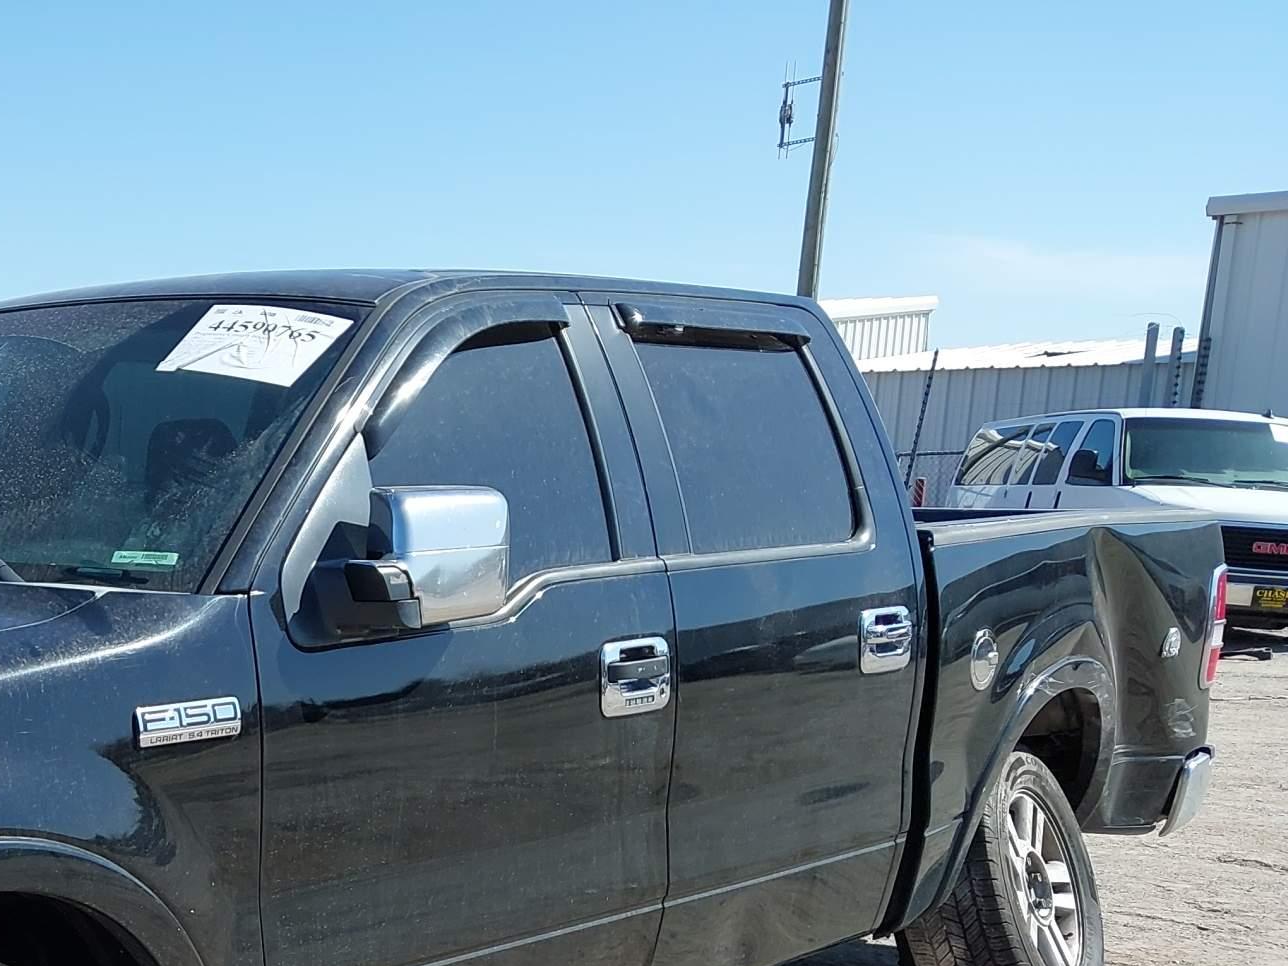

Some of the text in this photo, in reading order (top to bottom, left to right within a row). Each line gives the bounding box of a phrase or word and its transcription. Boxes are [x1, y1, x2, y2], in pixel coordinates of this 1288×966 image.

[1252, 541, 1288, 555] GM
[140, 700, 239, 732] F-150
[149, 733, 184, 744] LARIAT
[204, 726, 238, 737] TRITON
